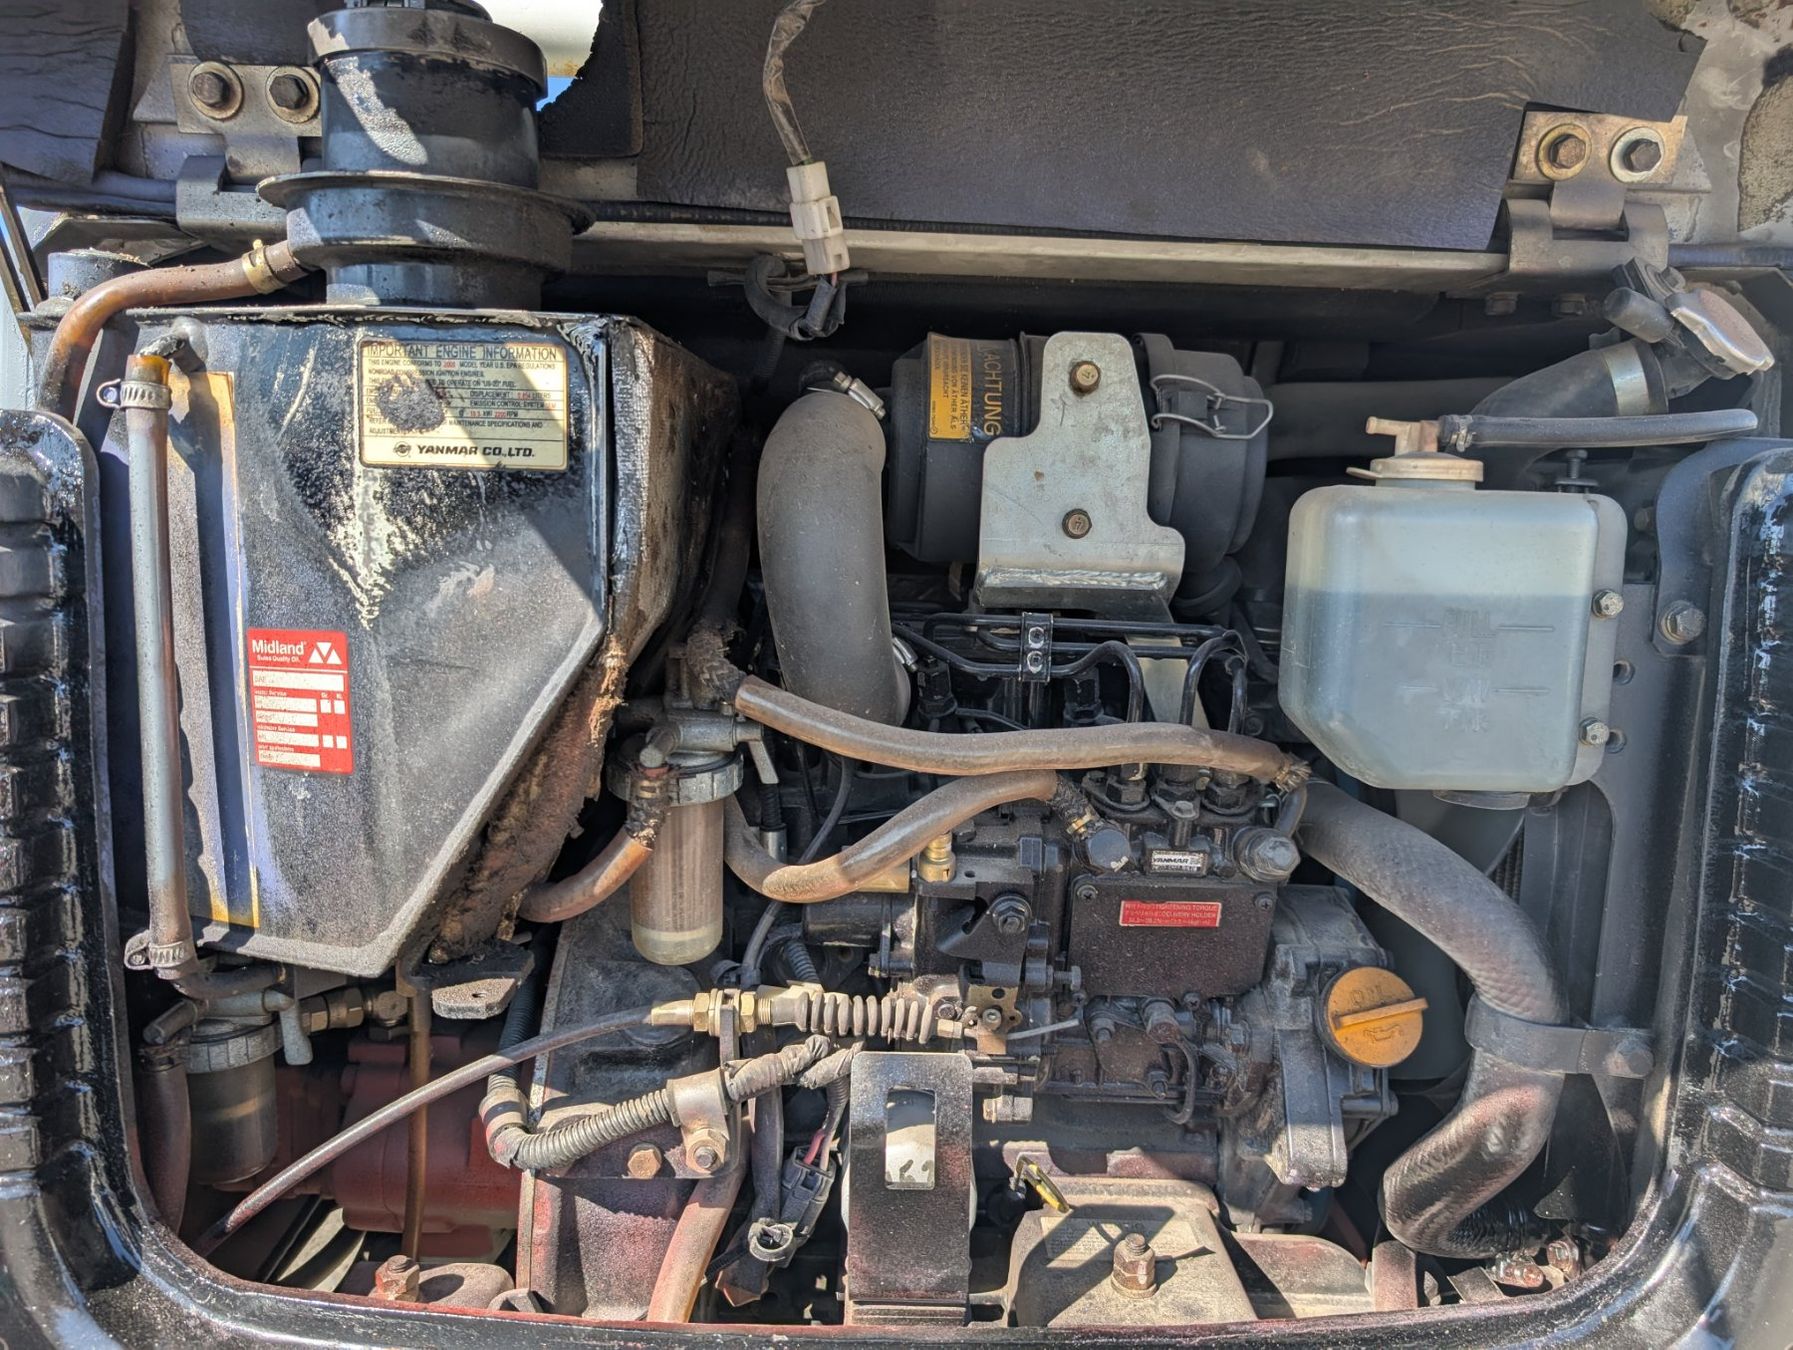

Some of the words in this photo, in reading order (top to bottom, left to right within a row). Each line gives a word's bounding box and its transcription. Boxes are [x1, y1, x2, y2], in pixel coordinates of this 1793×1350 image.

[367, 344, 429, 357] IMPORTANT
[436, 345, 477, 358] ENGINE
[482, 345, 557, 359] INFORMATION
[983, 352, 1002, 436] ACHTUNG
[417, 444, 478, 455] YANMAR
[482, 446, 535, 457] CO.,LTD.
[252, 640, 304, 655] Midland
